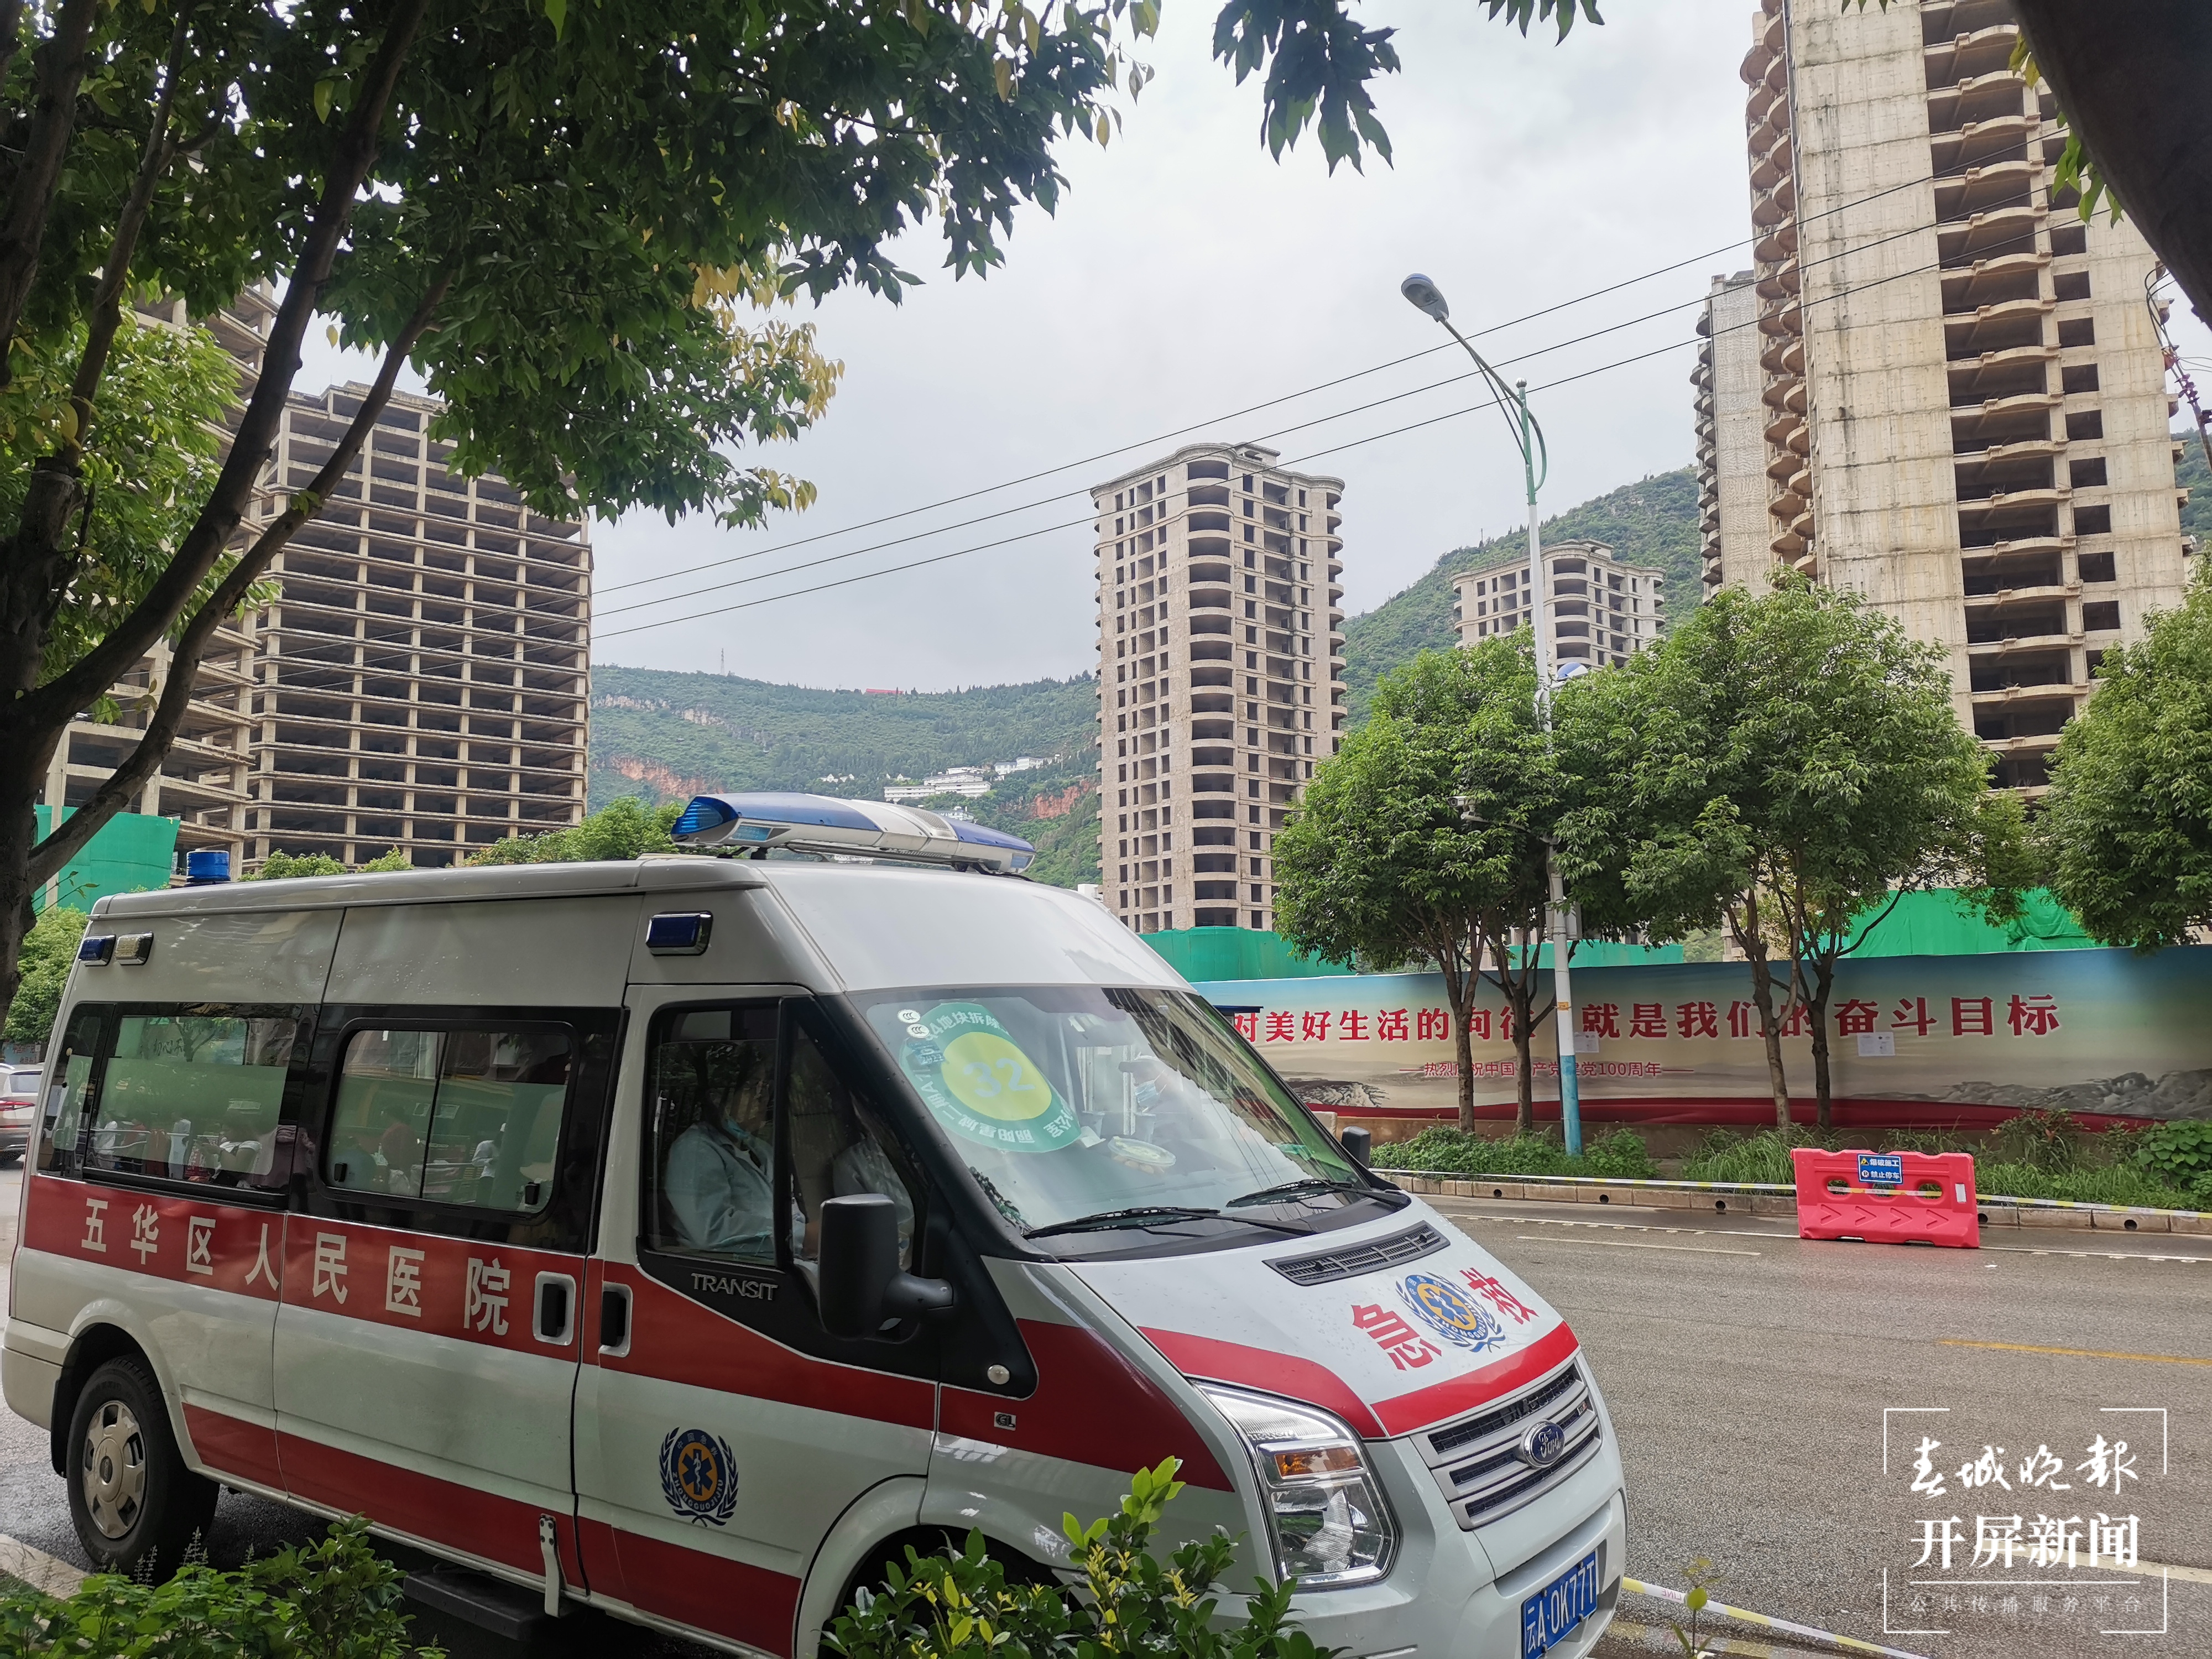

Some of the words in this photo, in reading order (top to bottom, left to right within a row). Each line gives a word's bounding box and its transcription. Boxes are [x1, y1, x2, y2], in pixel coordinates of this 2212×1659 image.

[1582, 994, 2060, 1038] 就是我们的奋斗目标
[963, 1057, 1036, 1098] 32
[1870, 1171, 1900, 1180] 禁止停车
[81, 1197, 510, 1335] 五华区人民医院
[691, 1272, 779, 1301] TRANSIT
[1352, 1304, 1442, 1371] 急
[1459, 1267, 1540, 1325] 救
[1538, 1428, 1562, 1458] Ford
[672, 1471, 723, 1511] ZHONGGUOJIJIU
